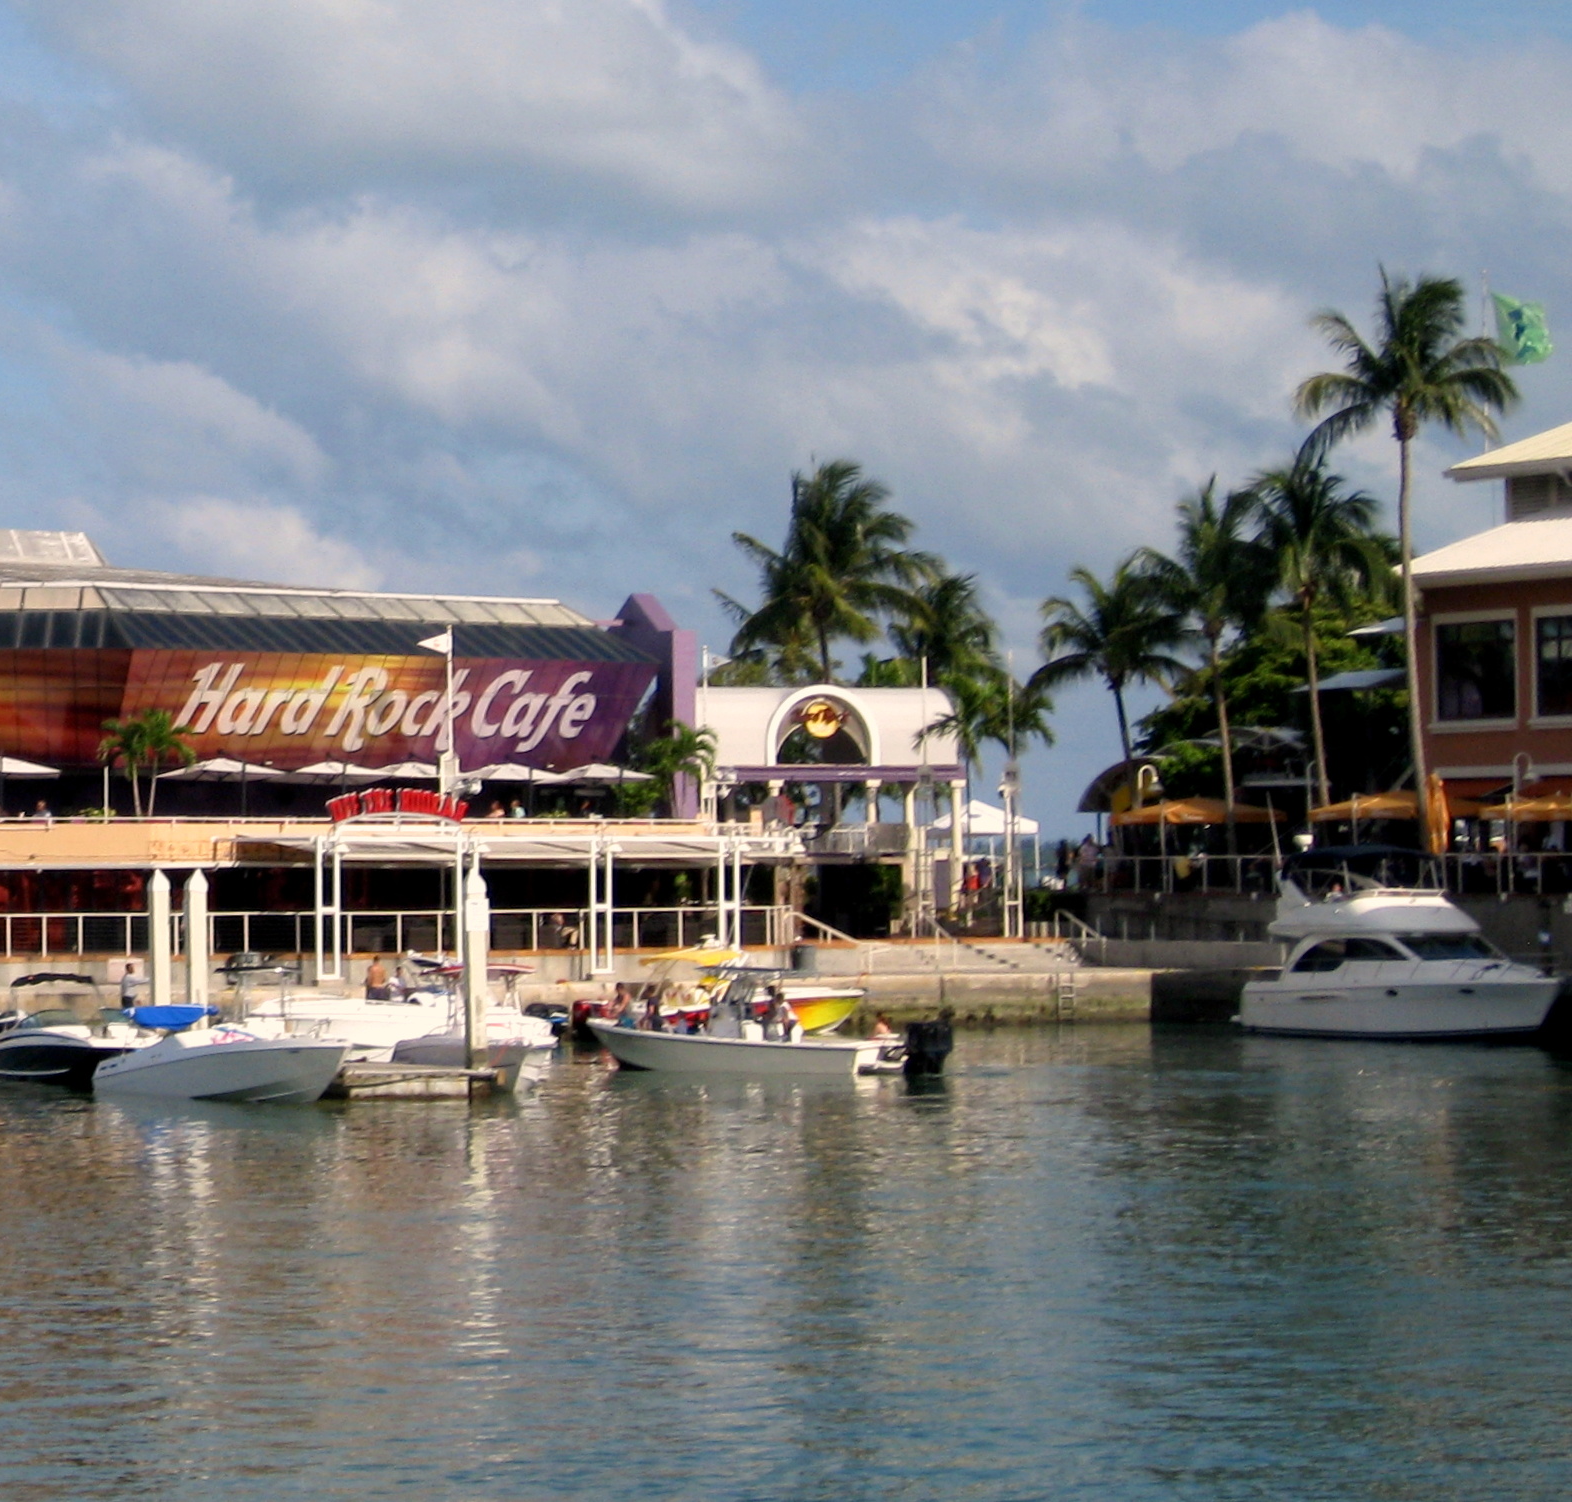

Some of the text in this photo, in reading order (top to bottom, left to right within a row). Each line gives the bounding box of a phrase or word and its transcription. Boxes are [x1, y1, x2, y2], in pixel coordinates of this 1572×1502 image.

[171, 662, 596, 753] Hard Rock Cafe
